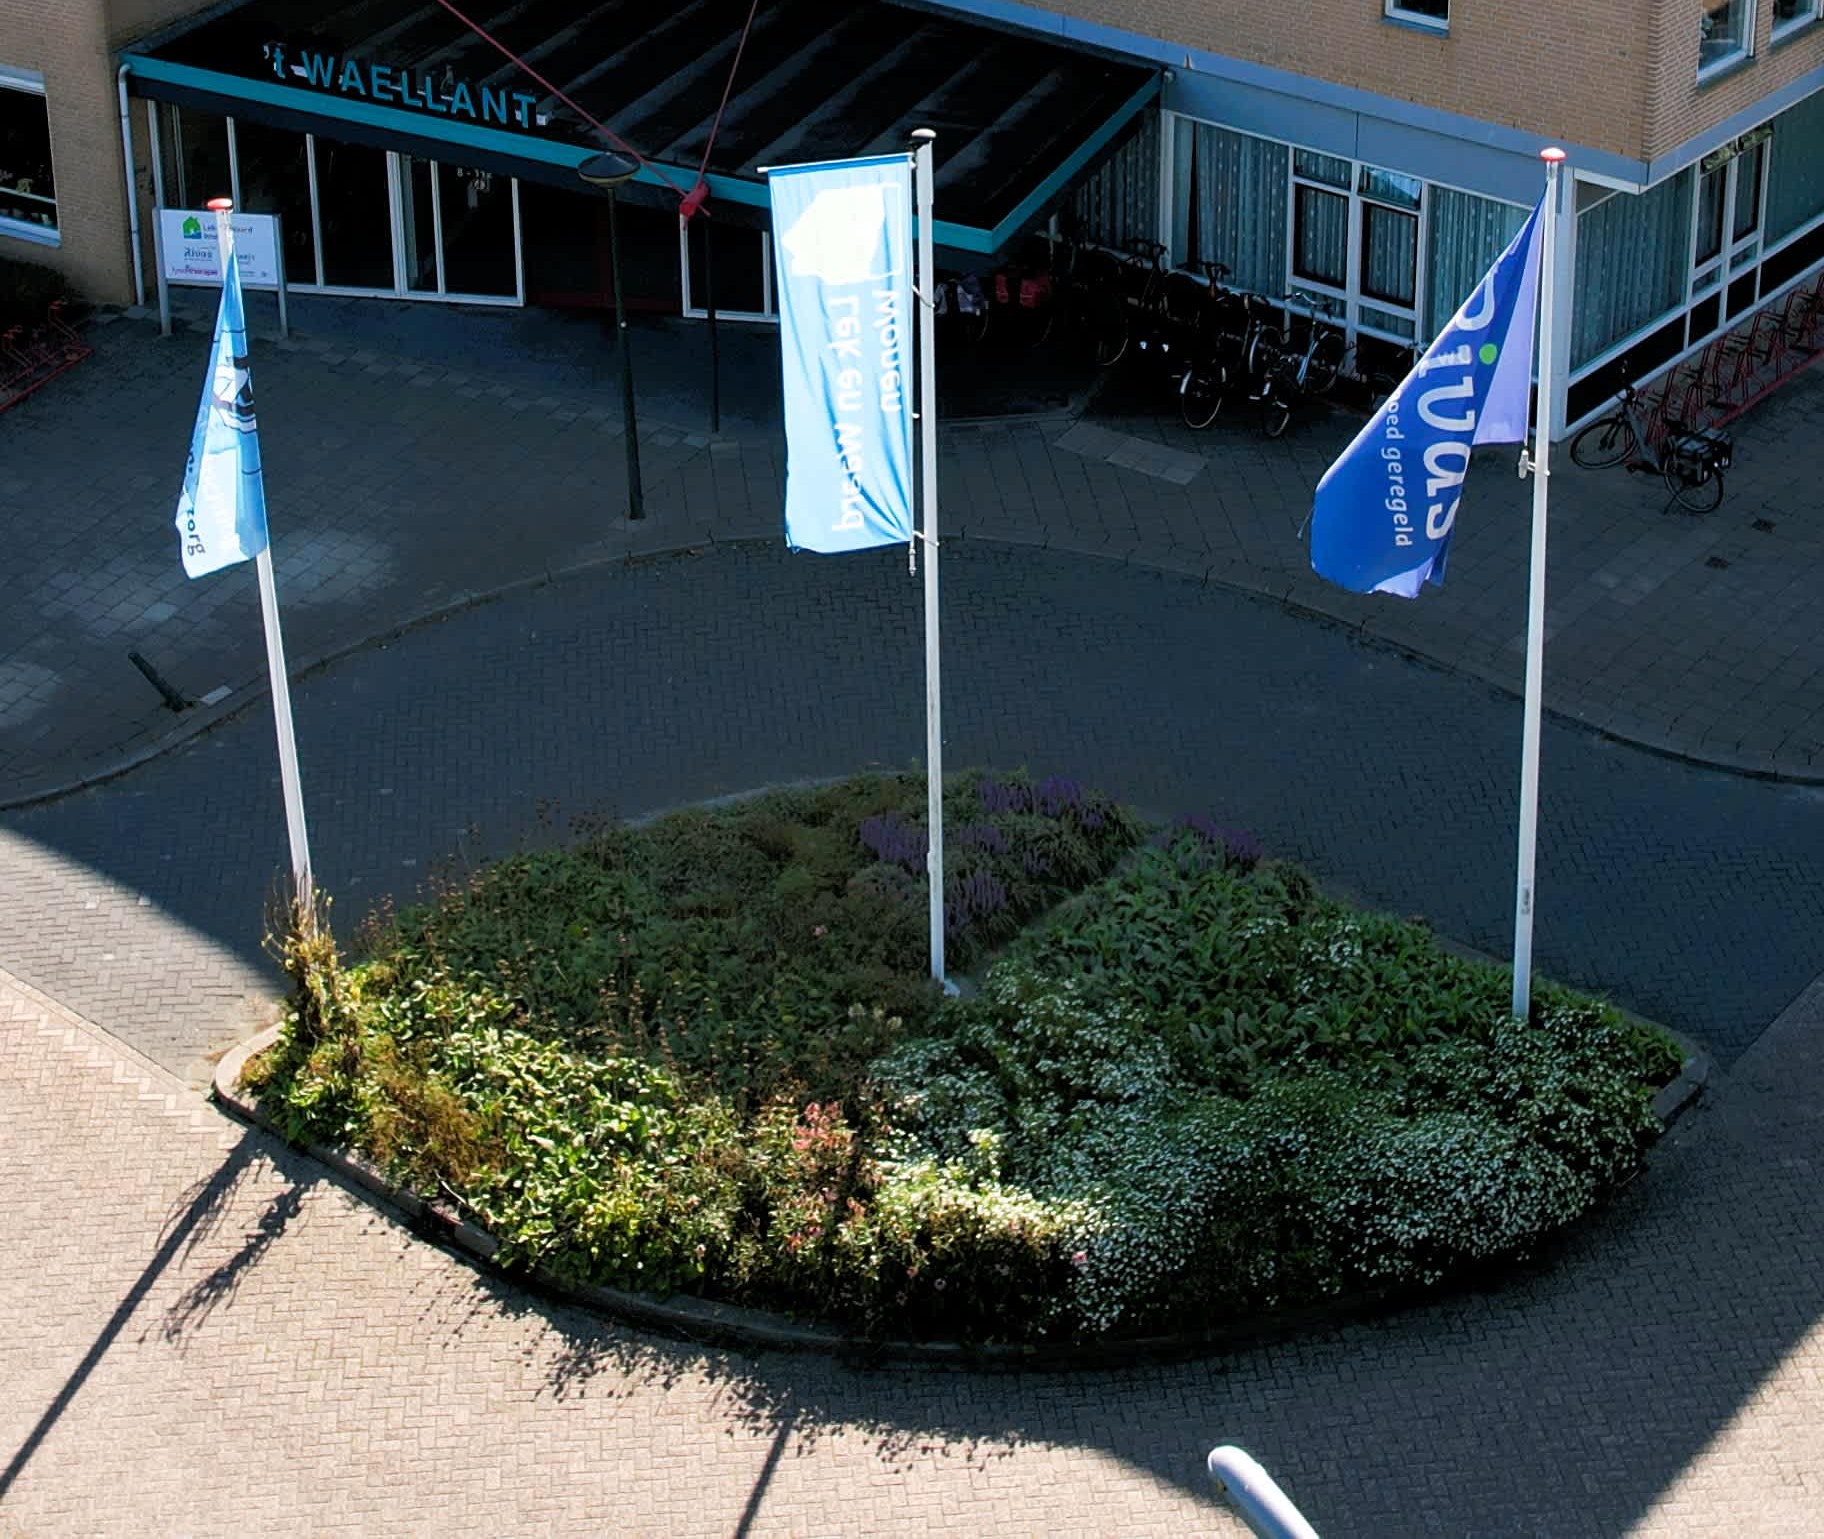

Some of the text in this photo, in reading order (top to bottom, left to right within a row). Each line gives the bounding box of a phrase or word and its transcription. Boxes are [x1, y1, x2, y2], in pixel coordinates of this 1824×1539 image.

[301, 50, 536, 129] WAELLANT
[1380, 392, 1413, 546] oed geregeld
